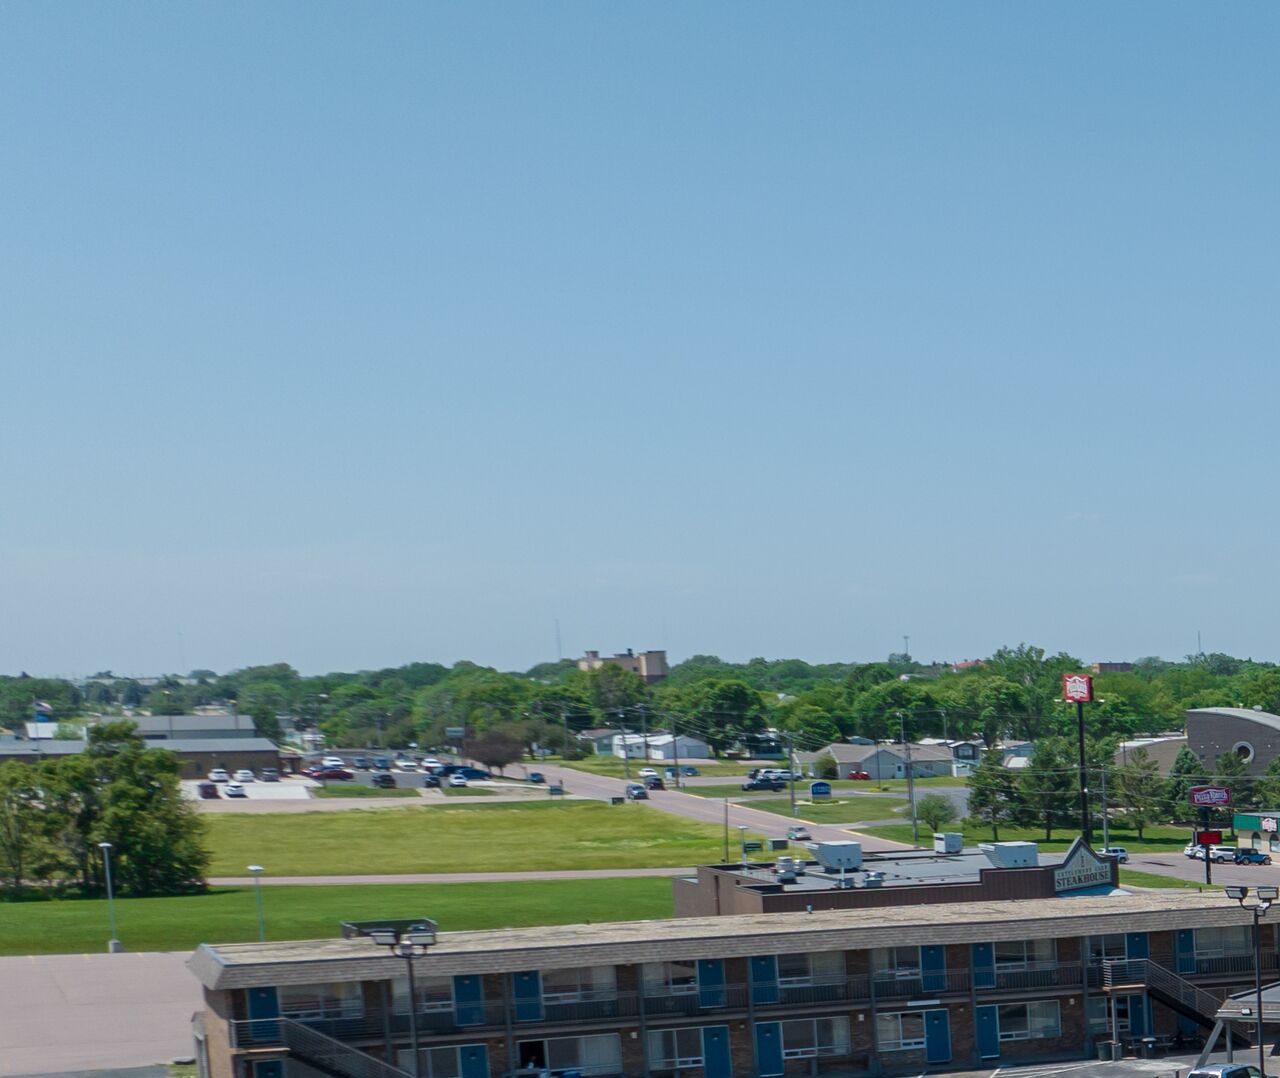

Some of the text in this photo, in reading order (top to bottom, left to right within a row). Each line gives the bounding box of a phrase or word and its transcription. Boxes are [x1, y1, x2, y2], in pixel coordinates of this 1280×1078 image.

[1194, 788, 1228, 803] Pizza Ranch
[1056, 870, 1109, 888] STEAKHOUSE
